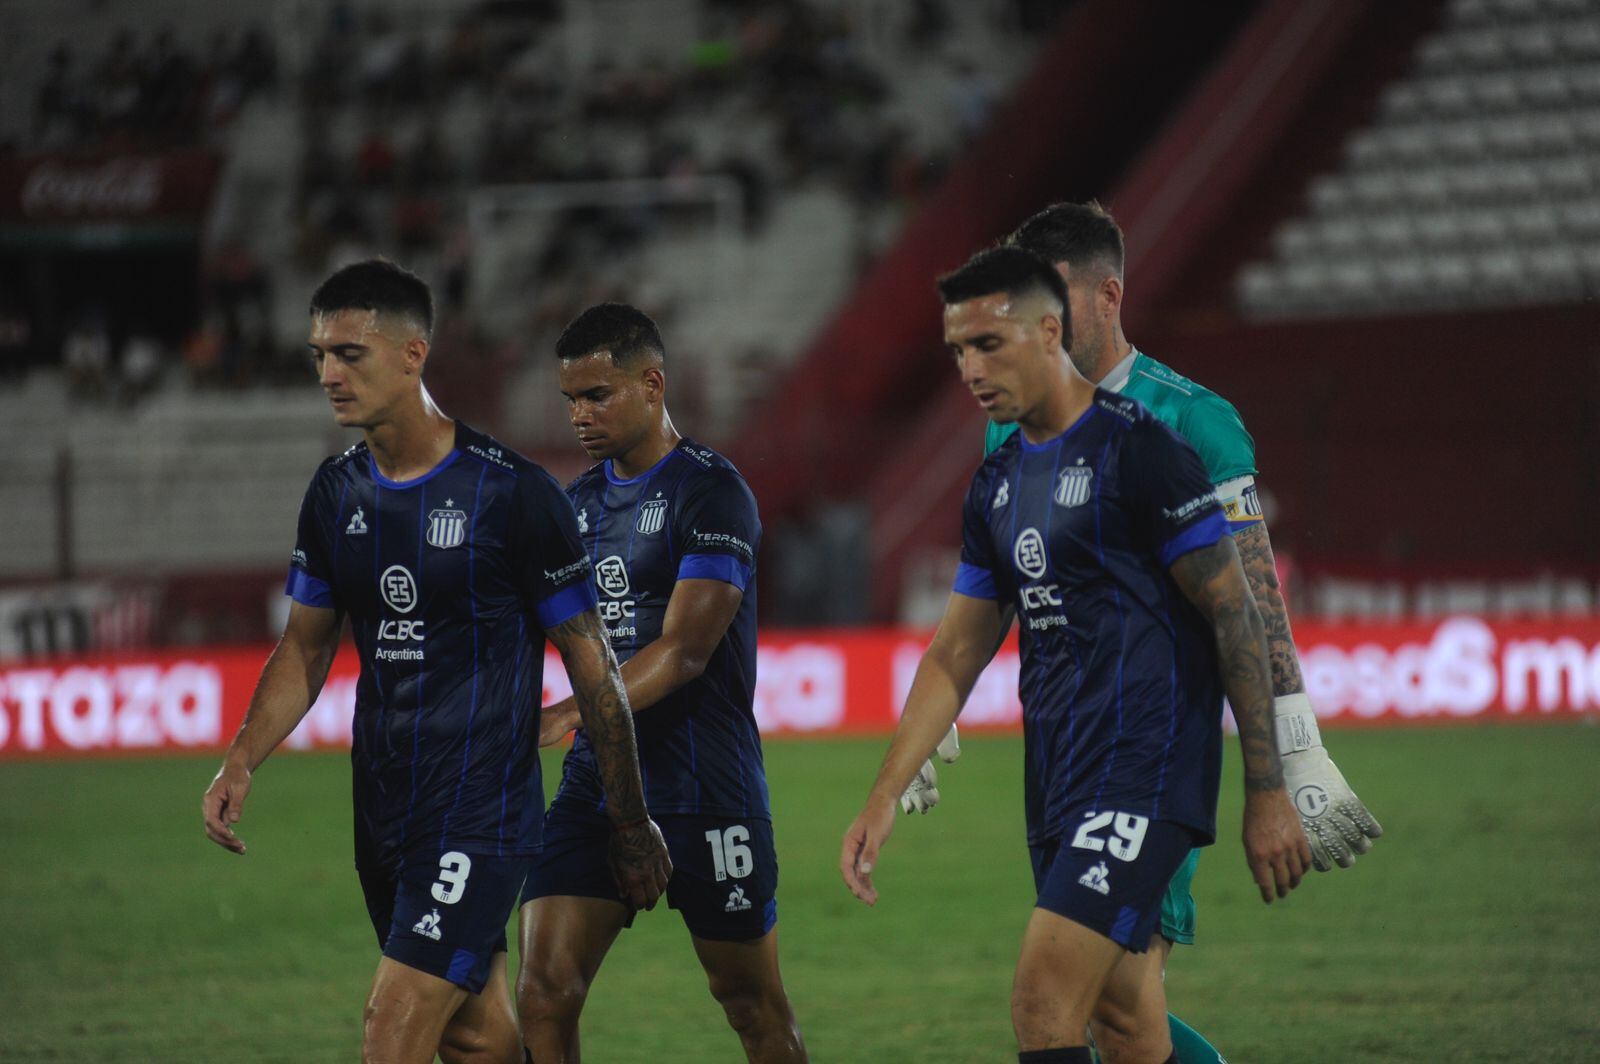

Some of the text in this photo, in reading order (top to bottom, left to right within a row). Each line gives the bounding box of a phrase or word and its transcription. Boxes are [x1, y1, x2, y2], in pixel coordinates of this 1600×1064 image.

[598, 600, 636, 621] CBC
[377, 619, 425, 641] ICBC
[608, 625, 637, 638] entina
[375, 647, 425, 663] Argentina
[1071, 811, 1149, 862] 29
[705, 825, 753, 881] 16
[431, 851, 471, 904] 3
